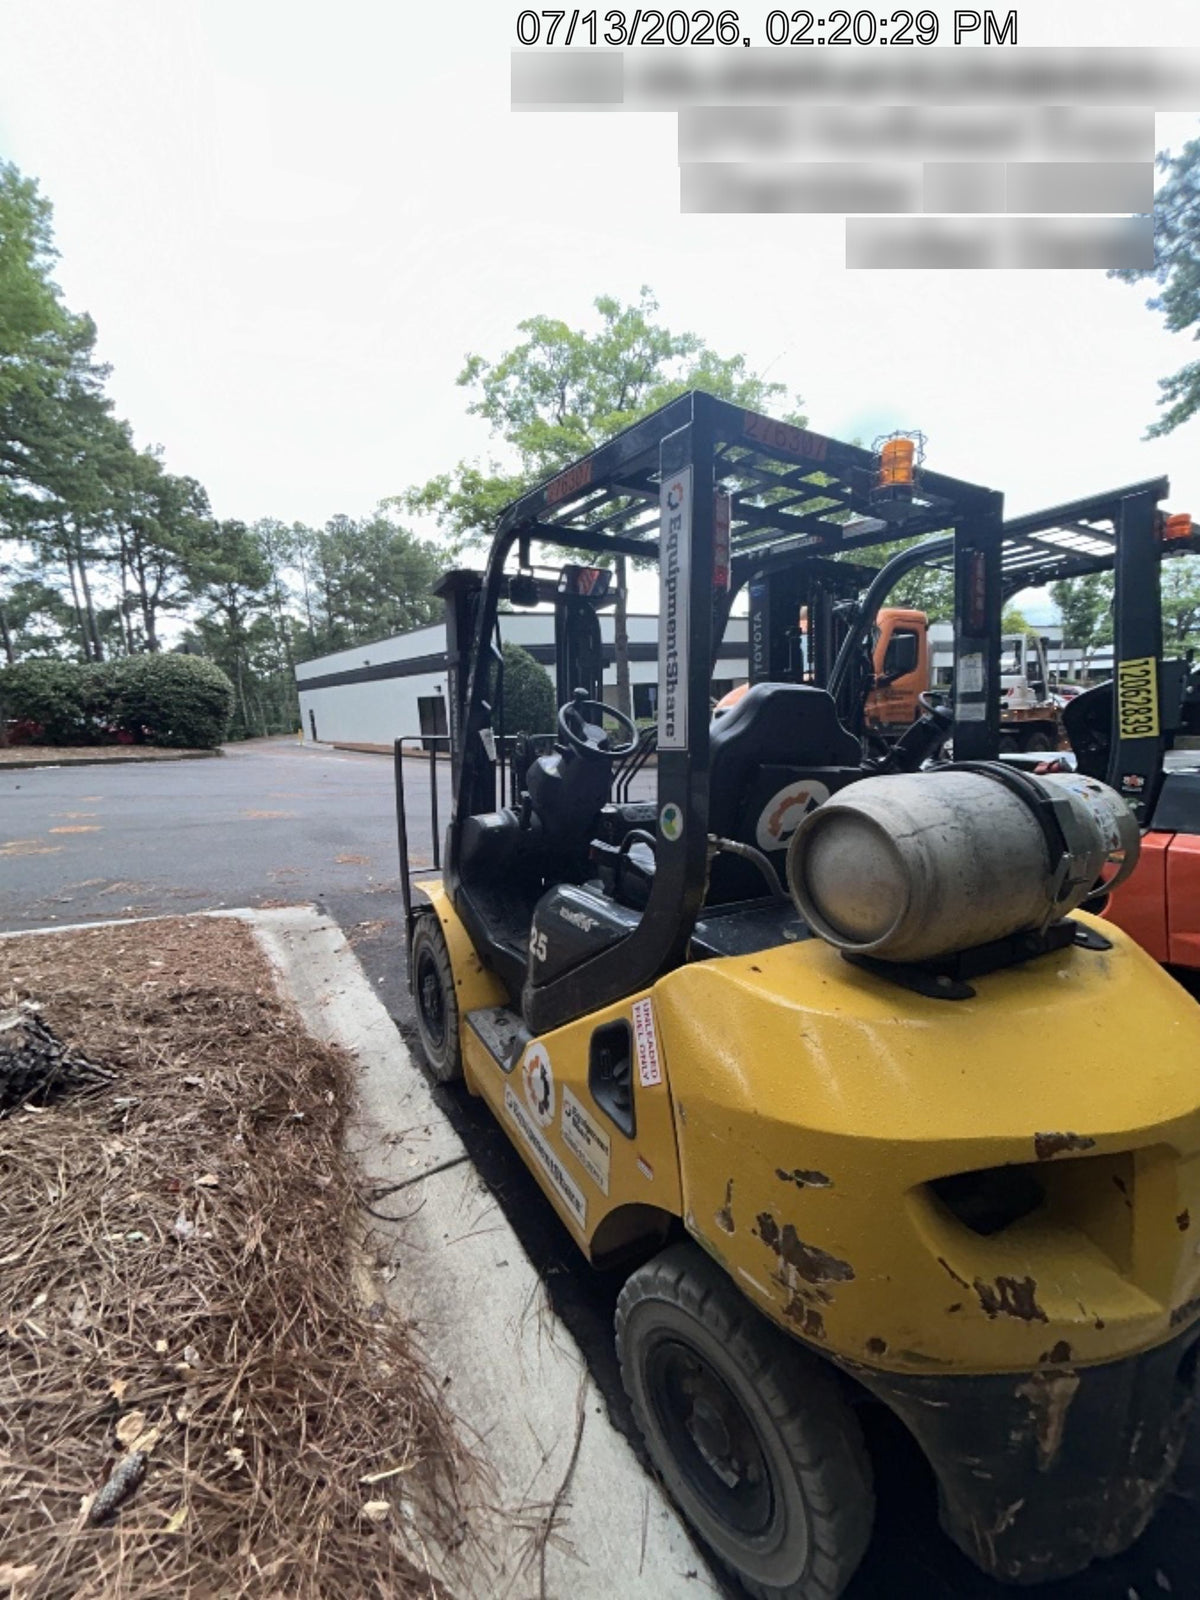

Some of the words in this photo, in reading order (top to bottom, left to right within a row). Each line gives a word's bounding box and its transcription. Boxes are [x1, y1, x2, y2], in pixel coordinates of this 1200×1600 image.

[665, 513, 682, 739] EquipmentShare
[753, 611, 763, 672] TOYOTA
[1119, 658, 1153, 735] 12062839
[529, 926, 548, 962] 25
[635, 1005, 644, 1041] FUEL
[640, 1044, 650, 1080] ONLY
[643, 1001, 658, 1079] UNLEADED
